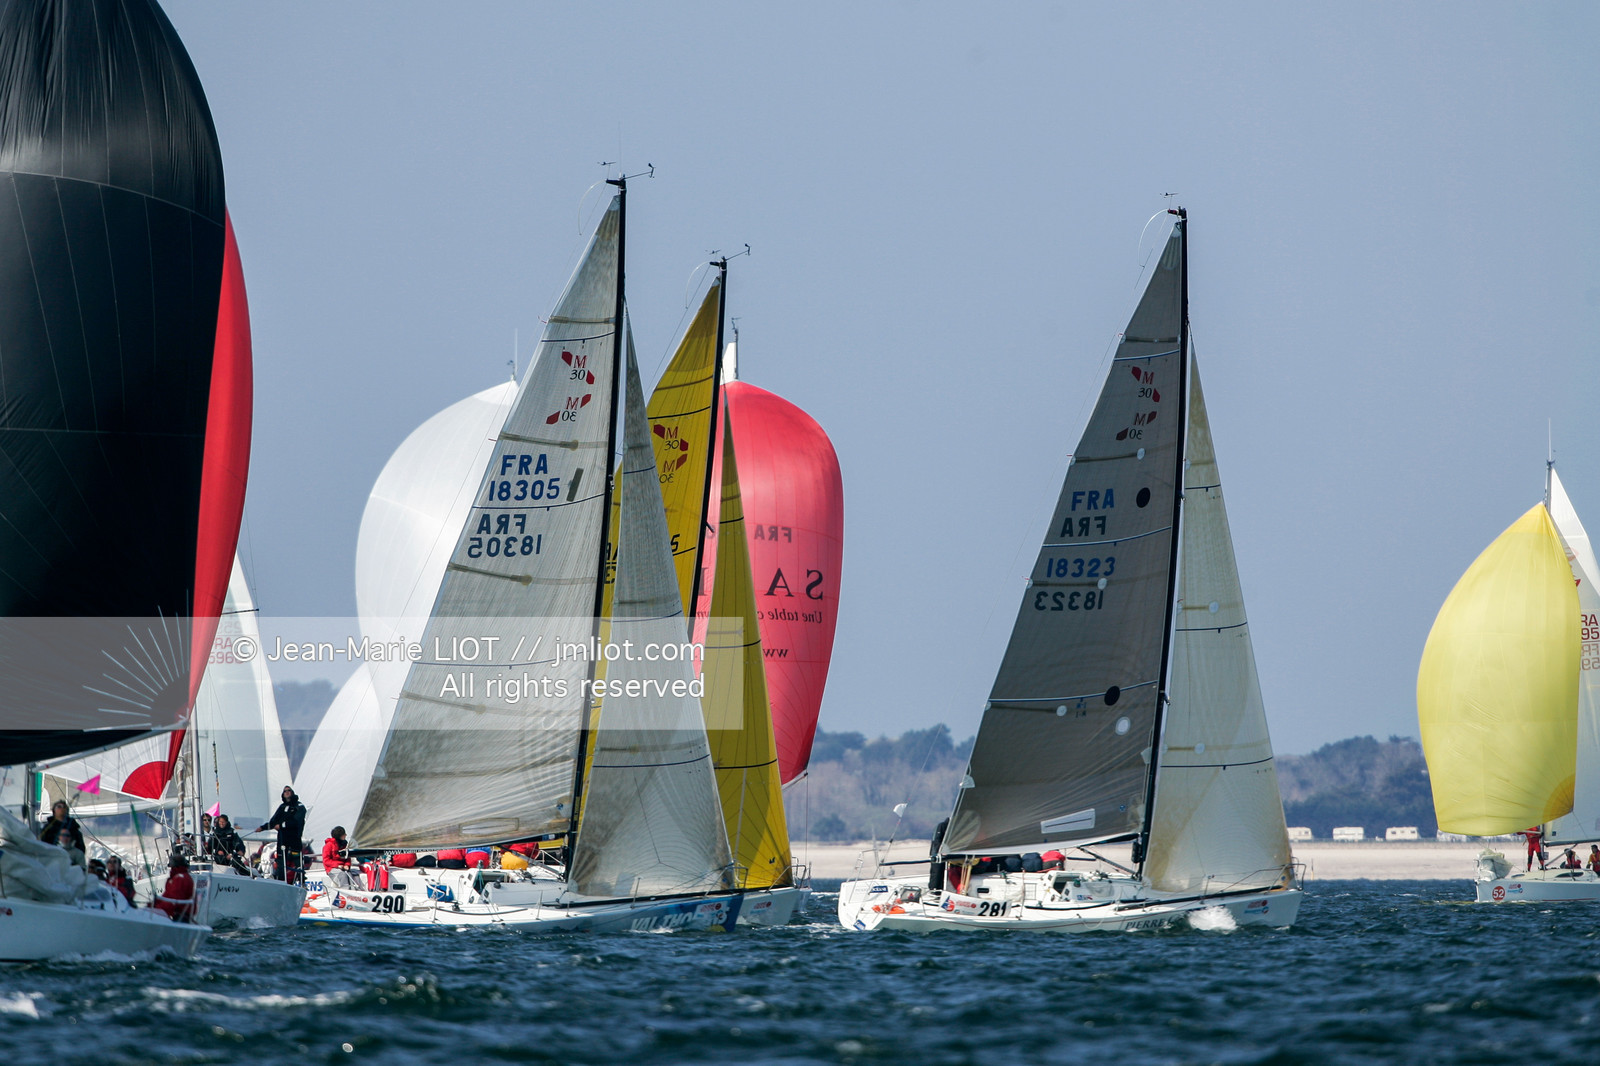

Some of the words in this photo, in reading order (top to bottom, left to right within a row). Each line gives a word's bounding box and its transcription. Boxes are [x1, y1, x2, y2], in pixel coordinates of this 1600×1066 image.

[573, 355, 587, 369] M
[570, 369, 586, 381] 30
[1141, 371, 1155, 385] M
[1137, 387, 1153, 399] 30
[665, 426, 679, 440] M
[664, 439, 680, 450] 30
[501, 453, 548, 476] FRA
[488, 478, 560, 501] 18305
[1070, 488, 1115, 511] FRA
[1047, 556, 1116, 578] 18323
[1581, 614, 1599, 626] RA
[1581, 627, 1600, 641] 95
[213, 636, 232, 650] RA
[303, 881, 323, 891] ENS
[1493, 889, 1505, 899] 52
[371, 894, 404, 913] 290
[978, 901, 1007, 917] 281
